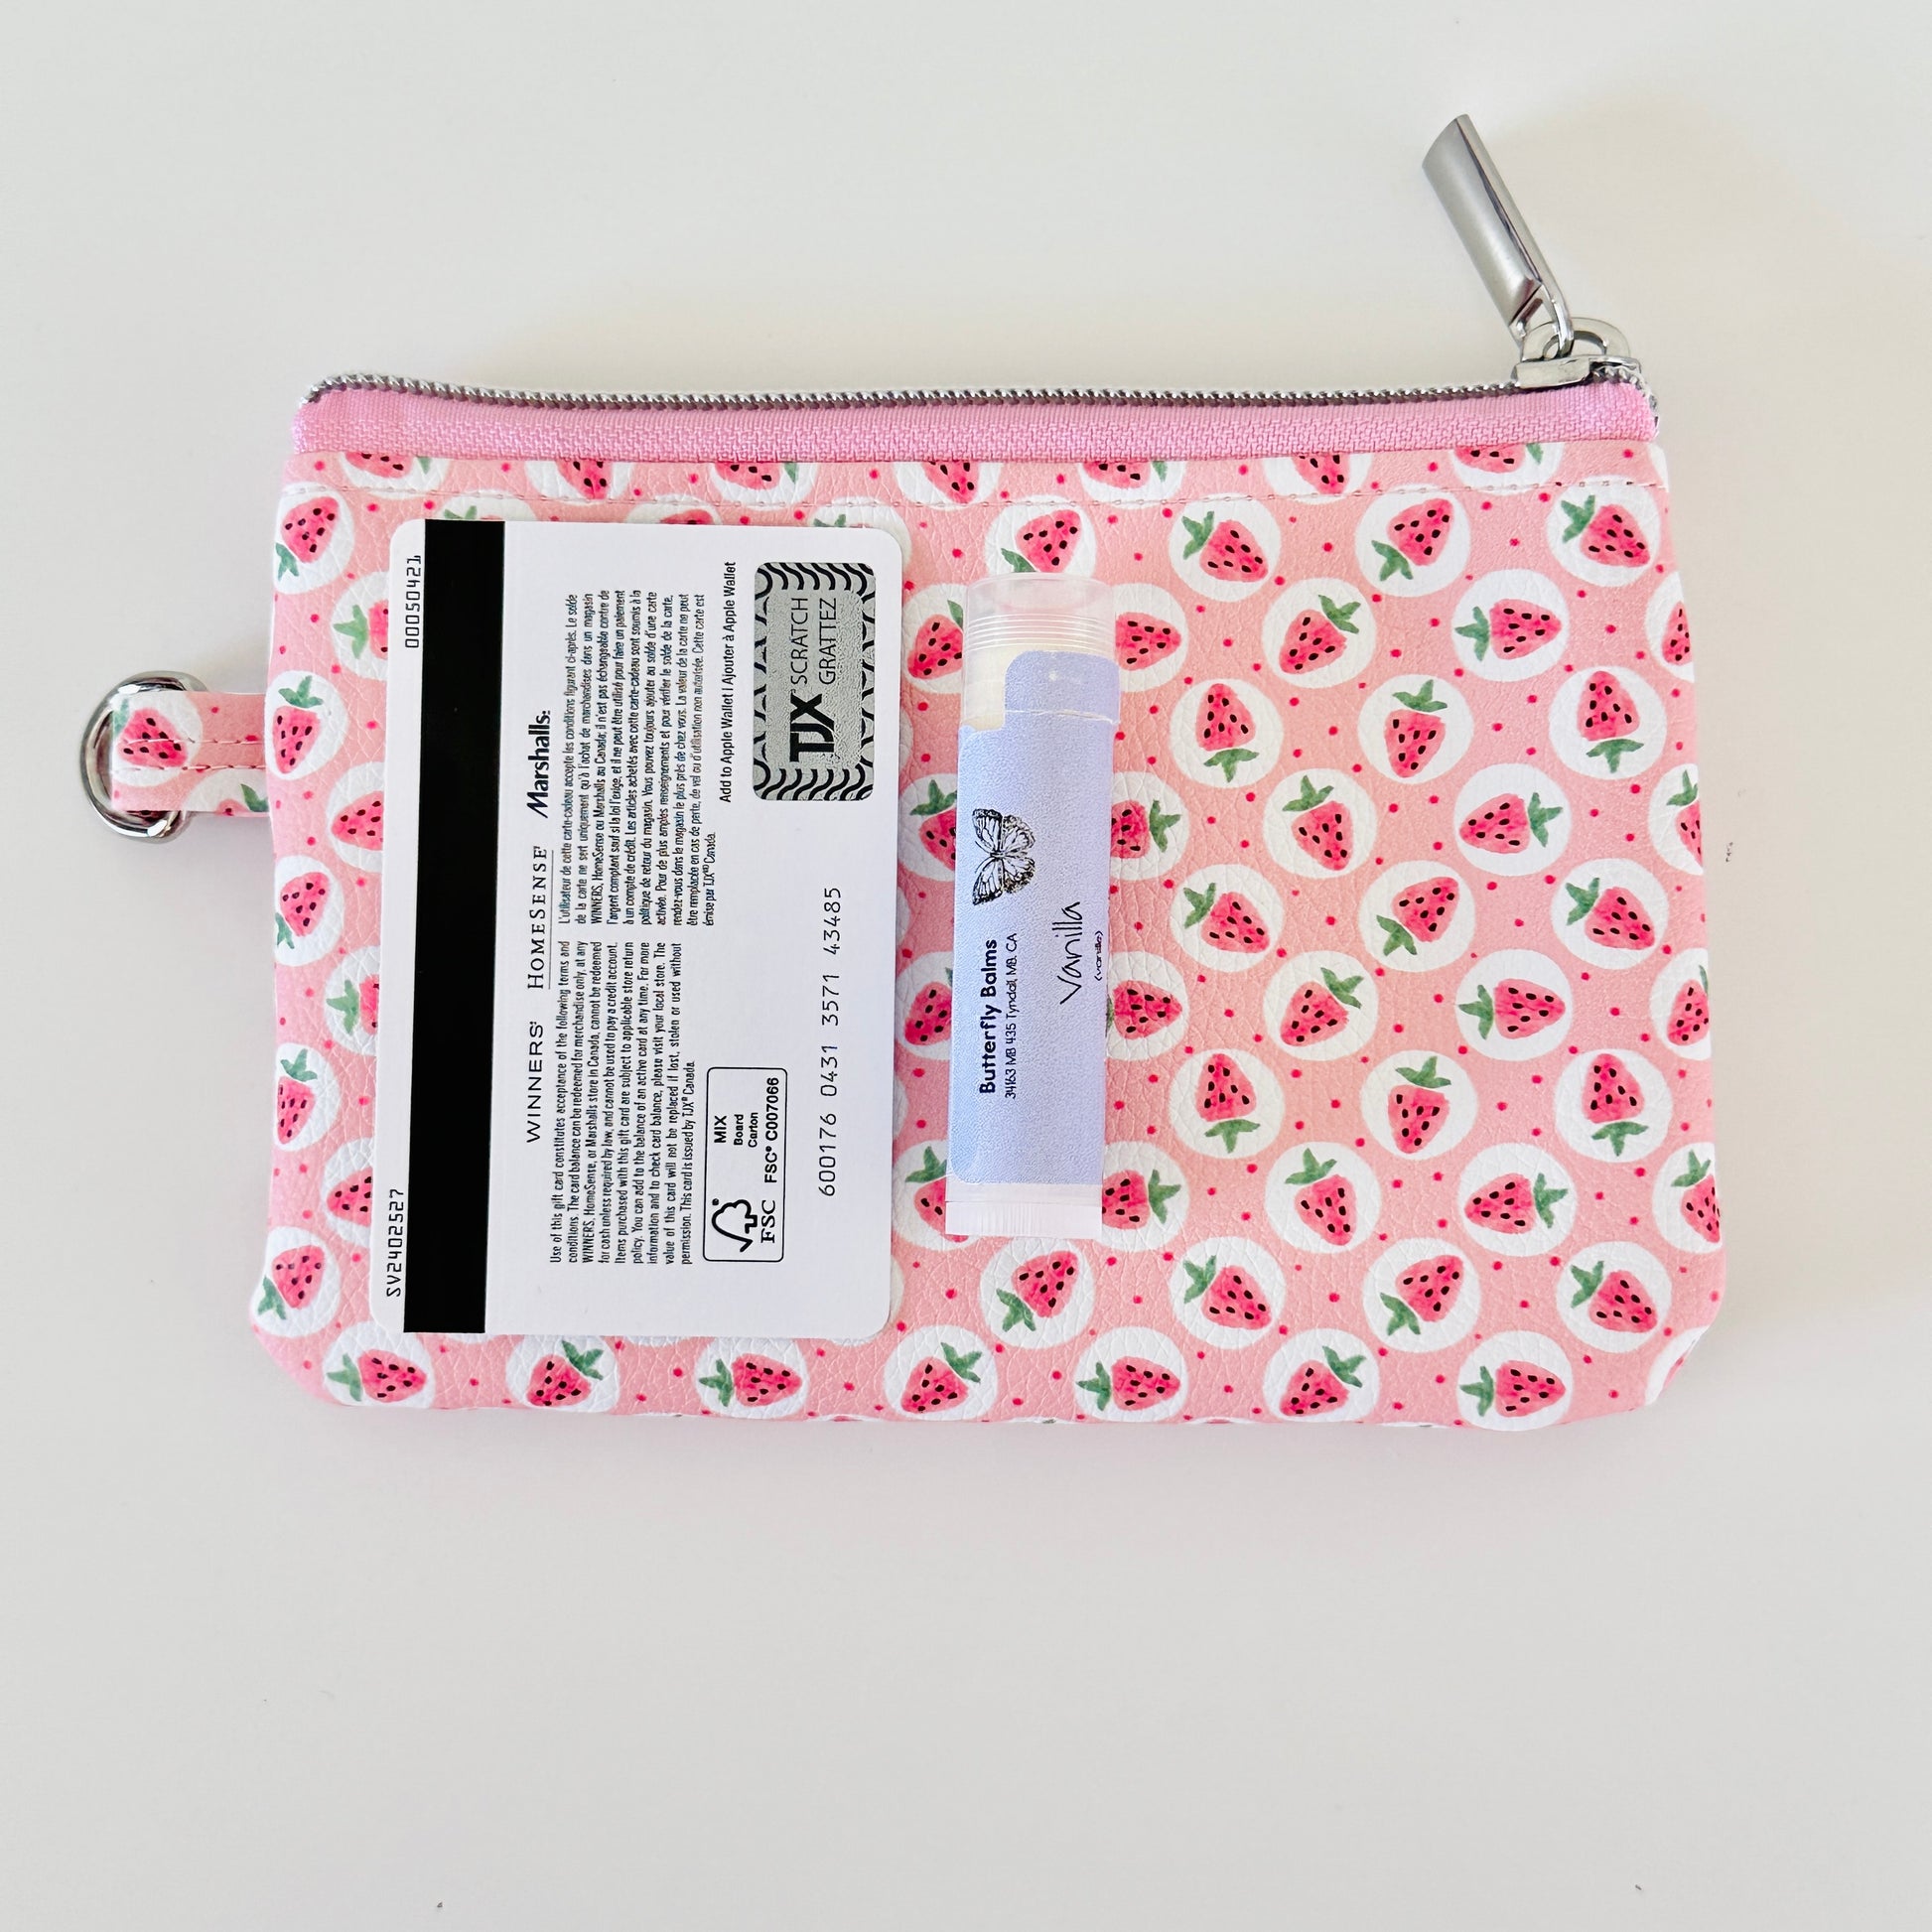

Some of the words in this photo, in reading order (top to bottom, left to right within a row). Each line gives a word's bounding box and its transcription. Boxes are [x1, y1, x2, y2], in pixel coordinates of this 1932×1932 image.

[723, 561, 736, 597] Wallet
[405, 555, 420, 647] 00050421
[723, 599, 737, 632] Apple
[790, 597, 807, 684] SCRATCH
[818, 598, 838, 684] GRATTEZ
[721, 643, 736, 685] Ajouter
[720, 693, 733, 729] Wallet
[789, 692, 833, 762] TJX
[720, 731, 734, 763] Apple
[526, 715, 549, 818] Marshalls
[720, 765, 732, 776] to
[719, 779, 731, 802] Add
[823, 888, 840, 954] 43485
[557, 940, 570, 957] and
[576, 940, 588, 956] any
[639, 942, 649, 964] more
[1006, 933, 1017, 952] CA
[1052, 901, 1082, 1005] Vanilla
[574, 958, 585, 967] at
[589, 941, 602, 984] redeemed
[621, 941, 633, 968] return
[557, 960, 569, 986] terms
[636, 966, 648, 980] For
[980, 940, 997, 997] Balms
[588, 986, 601, 997] be
[621, 971, 632, 993] store
[604, 981, 617, 1007] credit
[821, 974, 839, 1026] 3571
[555, 989, 570, 1029] following
[572, 991, 584, 1046] merchandise
[589, 1000, 600, 1030] cannot
[620, 996, 633, 1040] applicable
[638, 1008, 650, 1023] any
[606, 1015, 618, 1031] pay
[636, 1026, 647, 1035] at
[1006, 1024, 1016, 1043] 435
[555, 1033, 567, 1046] the
[604, 1032, 616, 1041] to
[620, 1043, 631, 1052] to
[635, 1037, 647, 1056] card
[554, 1050, 567, 1059] of
[570, 1048, 583, 1060] for
[603, 1042, 616, 1064] used
[979, 1005, 1002, 1093] Butterfly
[1006, 1048, 1016, 1064] MB
[587, 1068, 599, 1077] in
[602, 1065, 615, 1076] be
[618, 1055, 632, 1087] subject
[635, 1058, 646, 1086] active
[820, 1045, 837, 1096] 0431
[555, 1062, 567, 1113] acceptance
[570, 1062, 583, 1106] redeemed
[587, 1079, 598, 1102] store
[603, 1078, 615, 1109] cannot
[636, 1088, 646, 1099] an
[621, 1090, 630, 1104] are
[633, 1101, 646, 1110] of
[569, 1107, 582, 1119] be
[602, 1110, 614, 1127] and
[618, 1107, 629, 1126] card
[764, 1077, 778, 1141] C007066
[572, 1120, 581, 1136] can
[585, 1104, 598, 1147] Marshalls
[632, 1113, 645, 1148] balance
[681, 1119, 696, 1129] by
[713, 1115, 726, 1143] MIX
[733, 1113, 744, 1145] Board
[748, 1112, 758, 1148] Carton
[553, 1117, 565, 1168] constitutes
[617, 1129, 630, 1145] gift
[681, 1131, 693, 1160] issued
[568, 1138, 581, 1173] balance
[587, 1149, 597, 1158] or
[600, 1148, 615, 1158] by
[617, 1147, 628, 1164] this
[632, 1150, 644, 1165] the
[818, 1113, 836, 1196] 600176
[551, 1171, 563, 1190] card
[567, 1173, 580, 1193] card
[601, 1160, 614, 1195] required
[616, 1167, 627, 1187] with
[632, 1168, 644, 1176] to
[680, 1171, 692, 1190] card
[631, 1178, 643, 1195] add
[550, 1193, 565, 1209] gift
[566, 1194, 579, 1211] The
[599, 1197, 612, 1226] unless
[616, 1189, 628, 1235] purchased
[633, 1197, 643, 1214] can
[679, 1192, 692, 1210] This
[550, 1212, 562, 1229] this
[630, 1216, 642, 1233] You
[760, 1199, 775, 1243] FSC
[386, 1188, 403, 1297] SV2402527
[549, 1233, 562, 1242] of
[599, 1228, 610, 1249] cash
[549, 1245, 561, 1262] Use
[597, 1251, 610, 1263] for
[614, 1238, 626, 1263] Items
